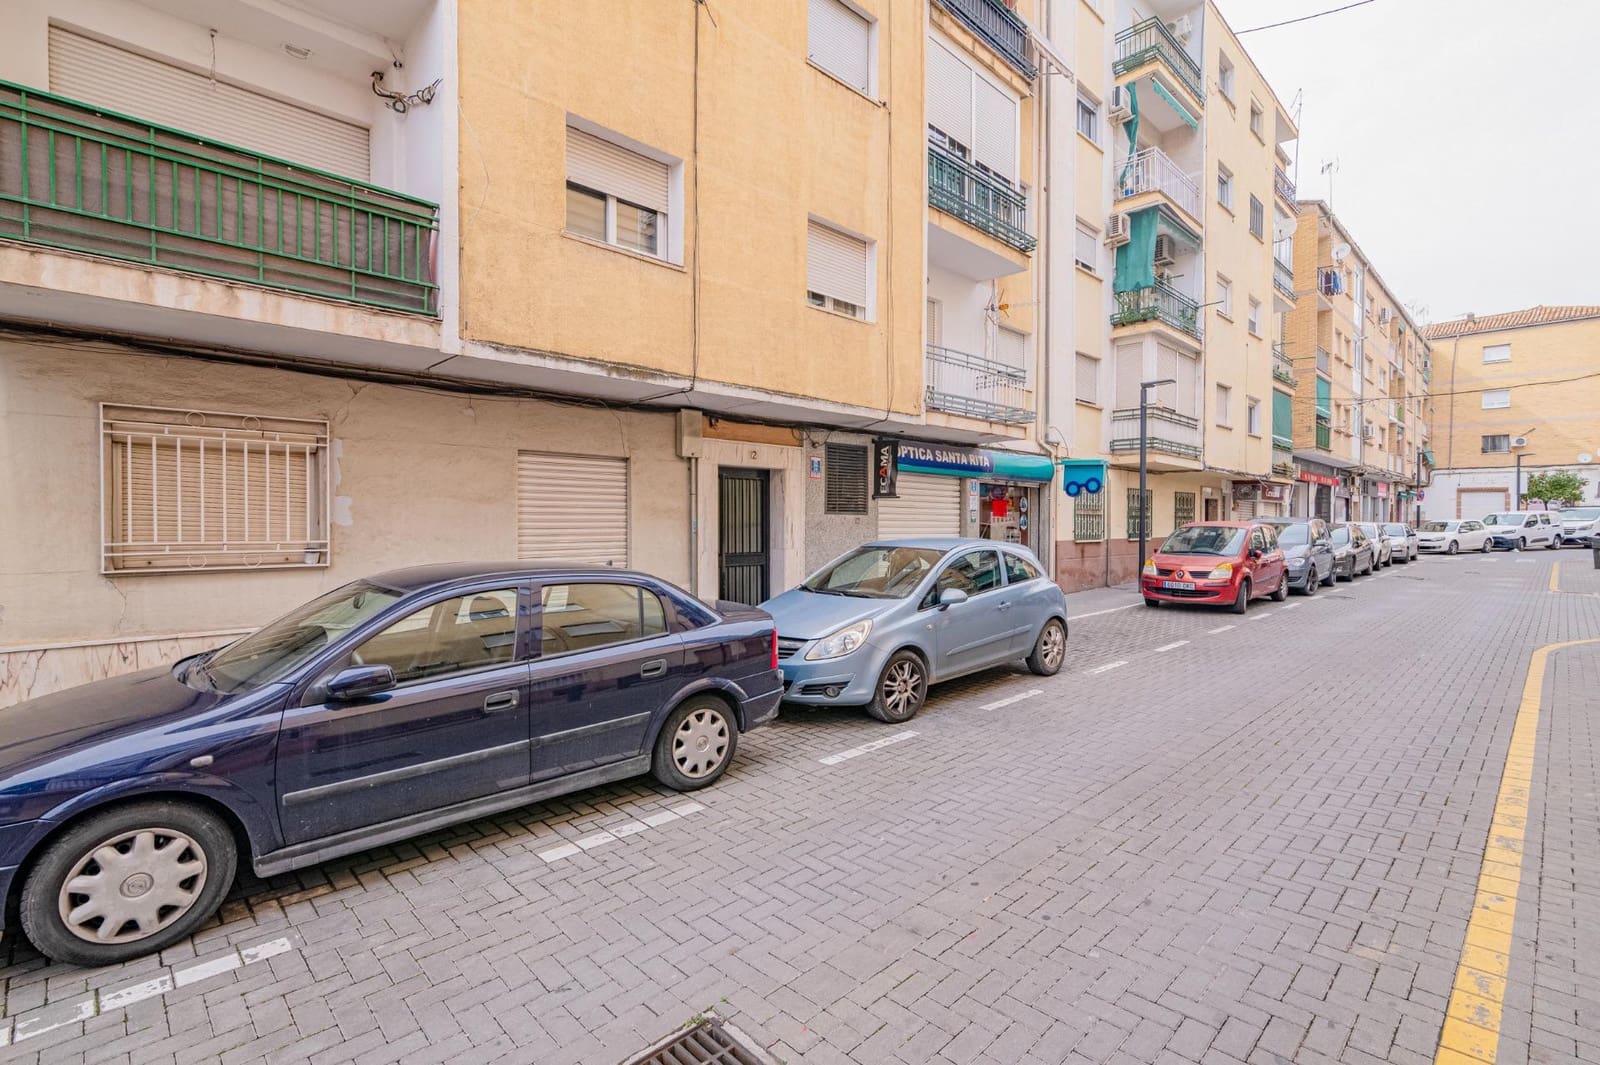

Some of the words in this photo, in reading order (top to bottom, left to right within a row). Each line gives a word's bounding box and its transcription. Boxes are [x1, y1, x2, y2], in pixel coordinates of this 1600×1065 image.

[880, 446, 889, 493] ECAMA
[935, 449, 967, 465] SANTA
[969, 454, 990, 467] RITA
